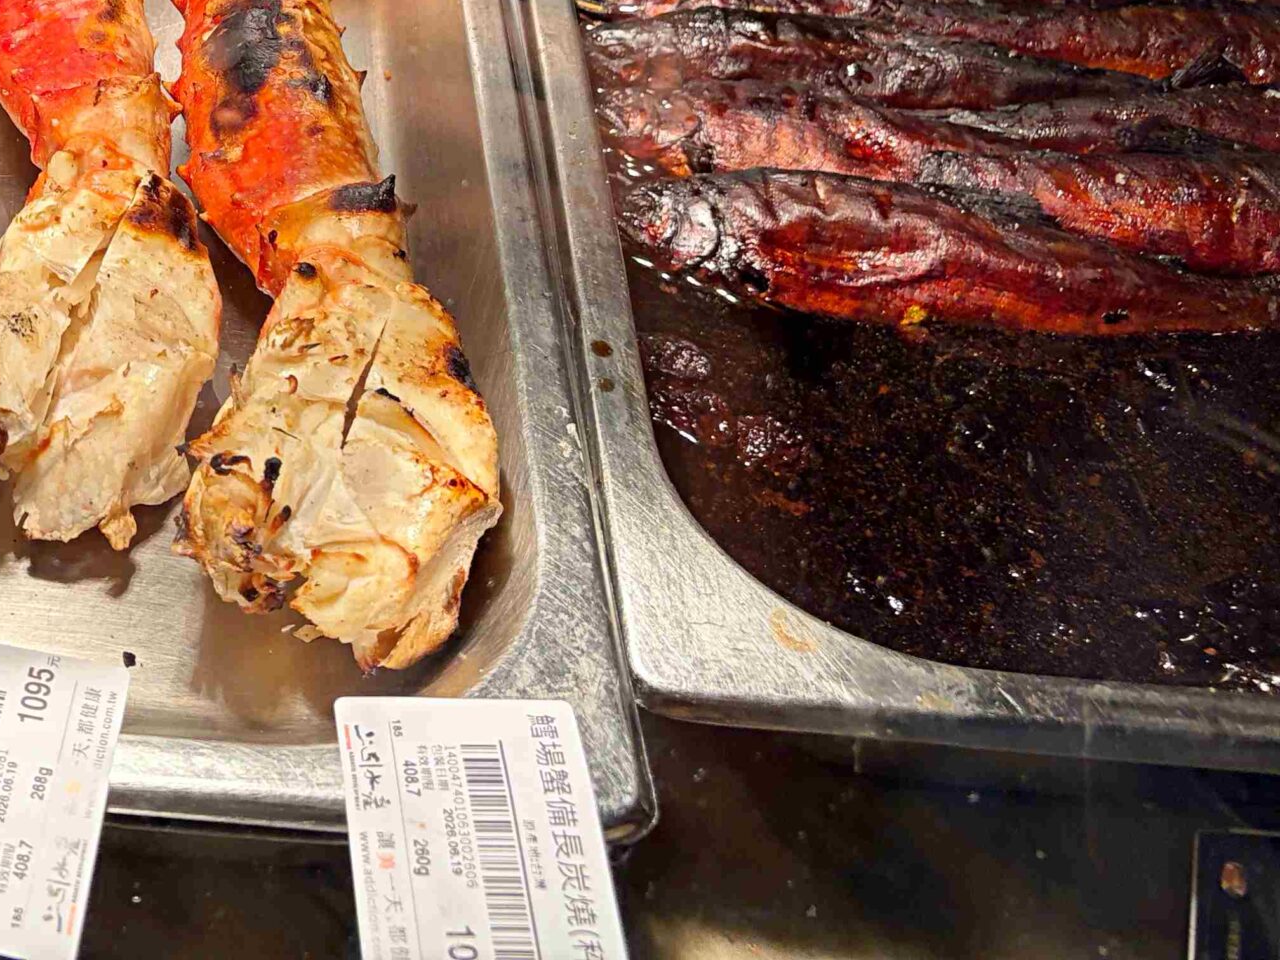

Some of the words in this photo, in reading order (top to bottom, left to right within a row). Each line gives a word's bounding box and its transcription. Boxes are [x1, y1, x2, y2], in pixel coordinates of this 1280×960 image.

[16, 665, 56, 723] 1095
[48, 654, 62, 668] 元
[11, 840, 33, 880] 408.7
[30, 765, 53, 801] 268g
[402, 759, 420, 796] 408.7
[412, 838, 430, 876] 260g
[444, 925, 479, 960] 10
